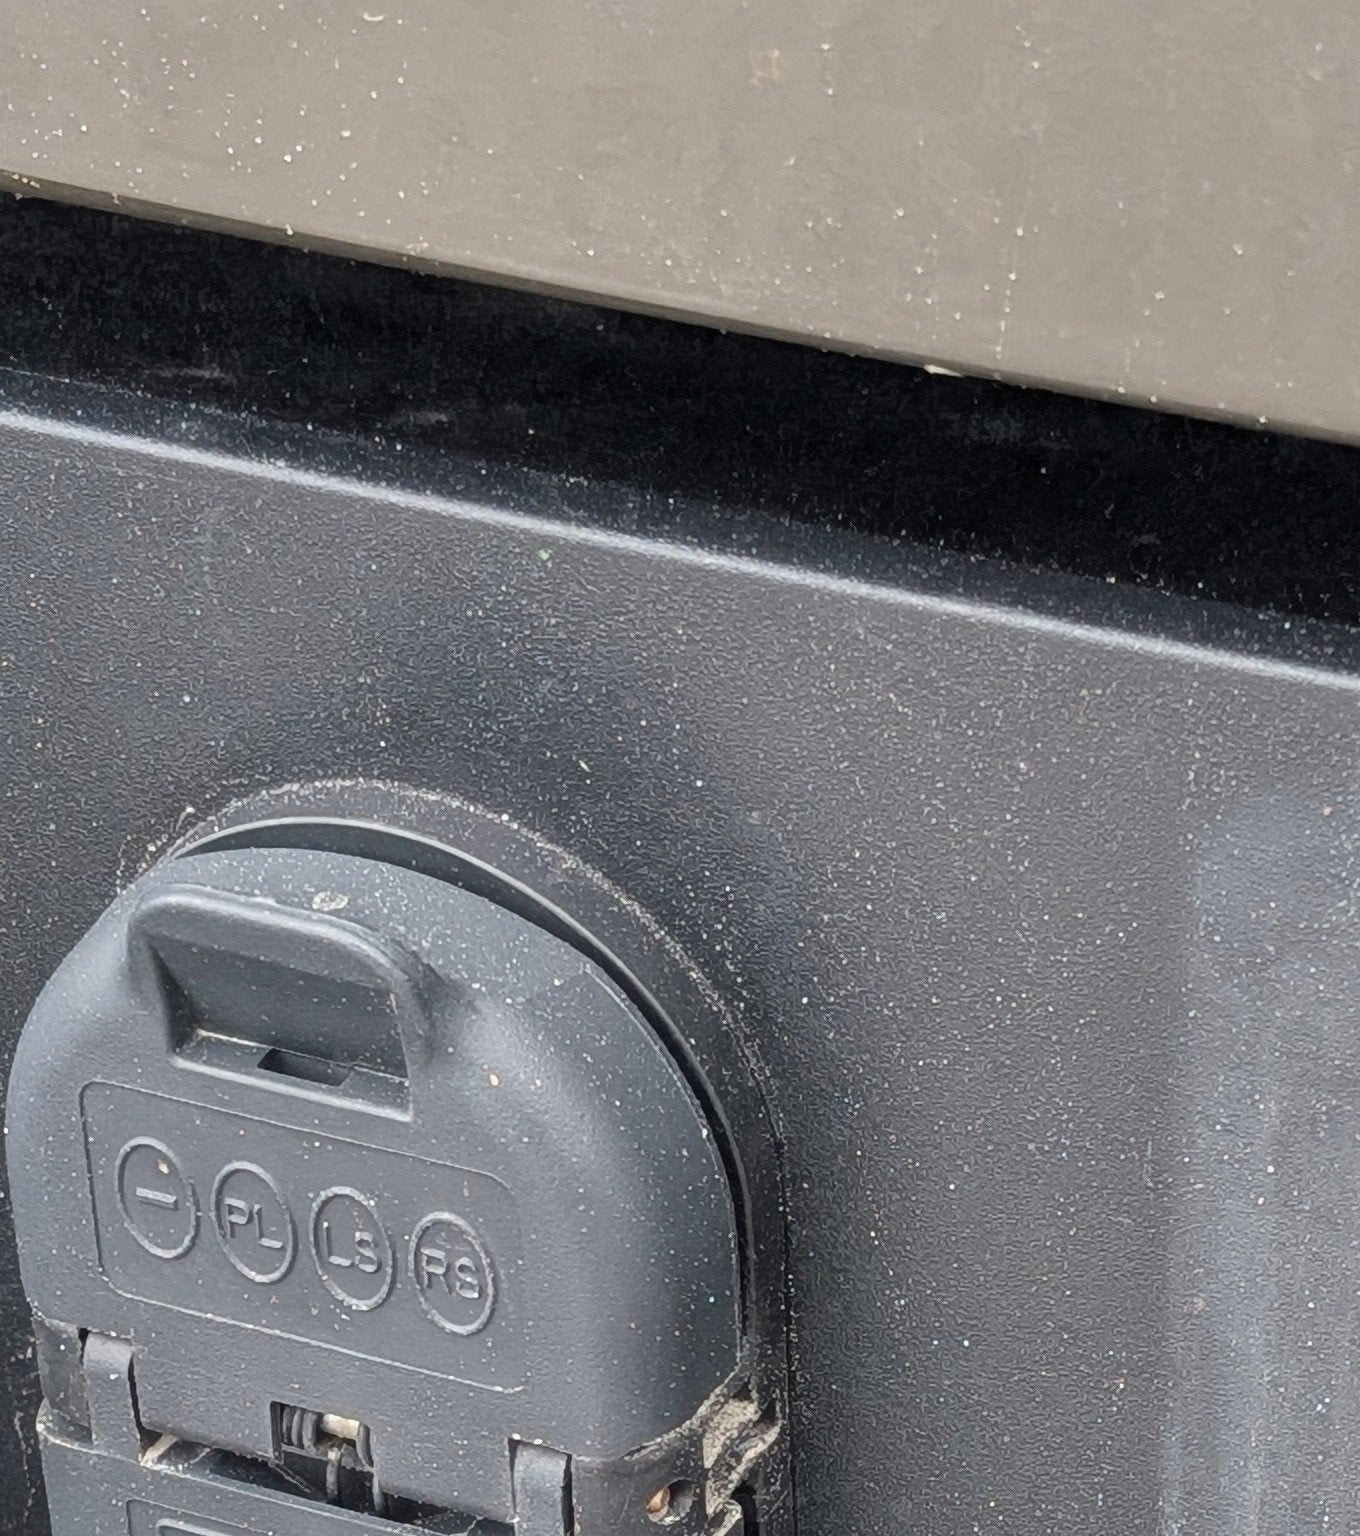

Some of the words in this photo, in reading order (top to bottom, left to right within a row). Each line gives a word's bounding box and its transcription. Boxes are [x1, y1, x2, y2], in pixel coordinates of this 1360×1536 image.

[224, 1196, 283, 1250] PL
[323, 1222, 381, 1275] LS
[421, 1246, 480, 1300] RS
